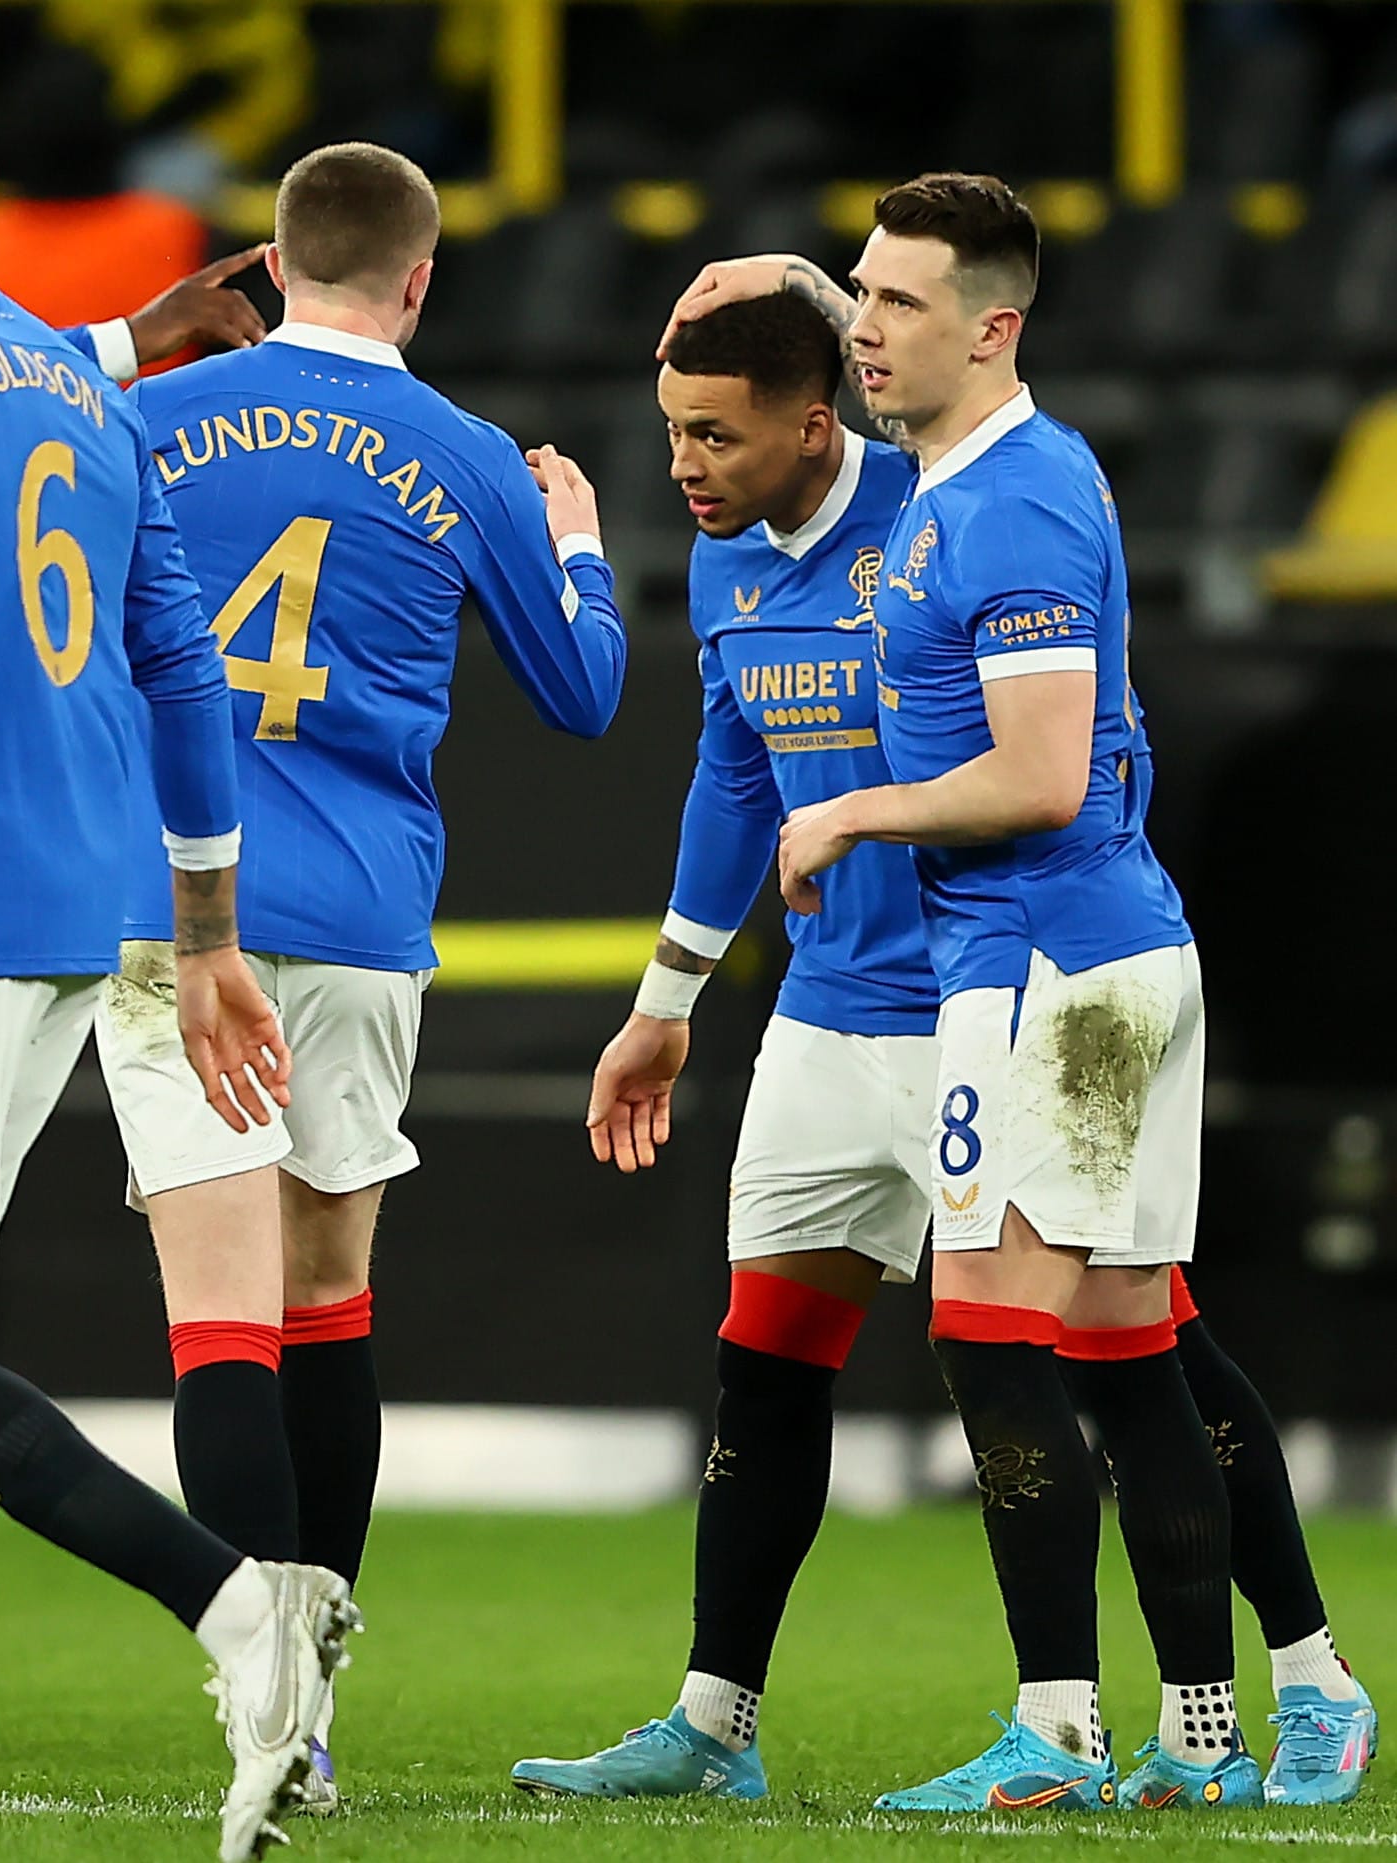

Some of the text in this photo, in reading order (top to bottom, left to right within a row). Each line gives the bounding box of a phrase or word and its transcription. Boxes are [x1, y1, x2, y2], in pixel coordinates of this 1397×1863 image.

[151, 406, 460, 543] LUNDSTRAM
[17, 440, 94, 687] 6
[207, 516, 333, 741] 4
[985, 605, 1079, 637] TOMKET
[741, 660, 862, 703] UNIBET
[940, 1084, 982, 1176] 8
